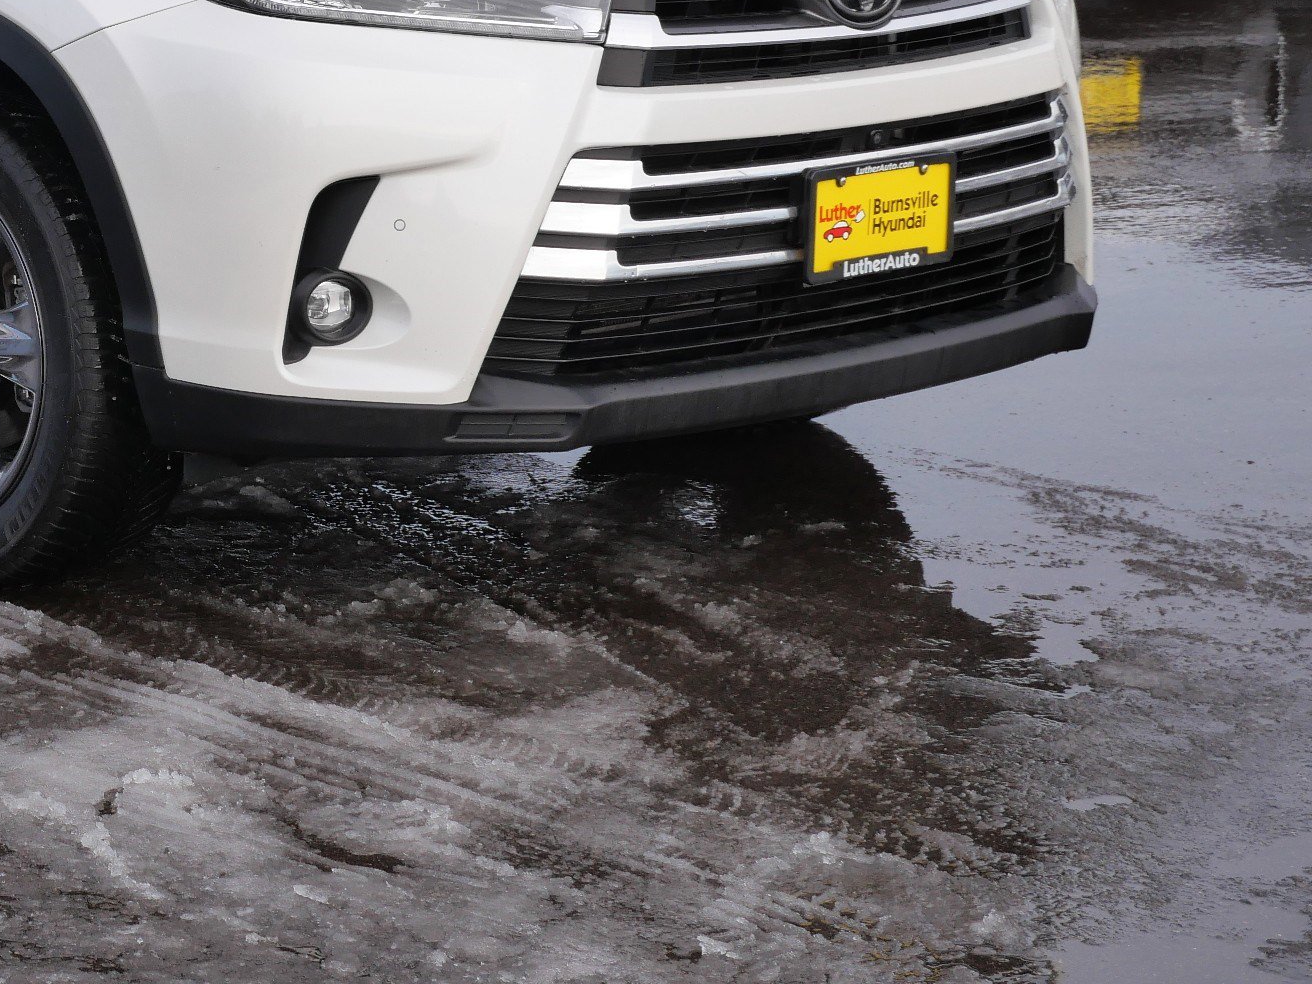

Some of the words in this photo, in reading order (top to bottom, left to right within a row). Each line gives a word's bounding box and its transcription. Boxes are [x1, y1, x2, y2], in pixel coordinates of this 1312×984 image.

[855, 161, 916, 176] LutherAuto.com
[819, 203, 862, 223] Luther
[873, 190, 939, 215] Burnsville
[872, 211, 927, 237] Hyundai
[843, 252, 920, 277] LutherAuto
